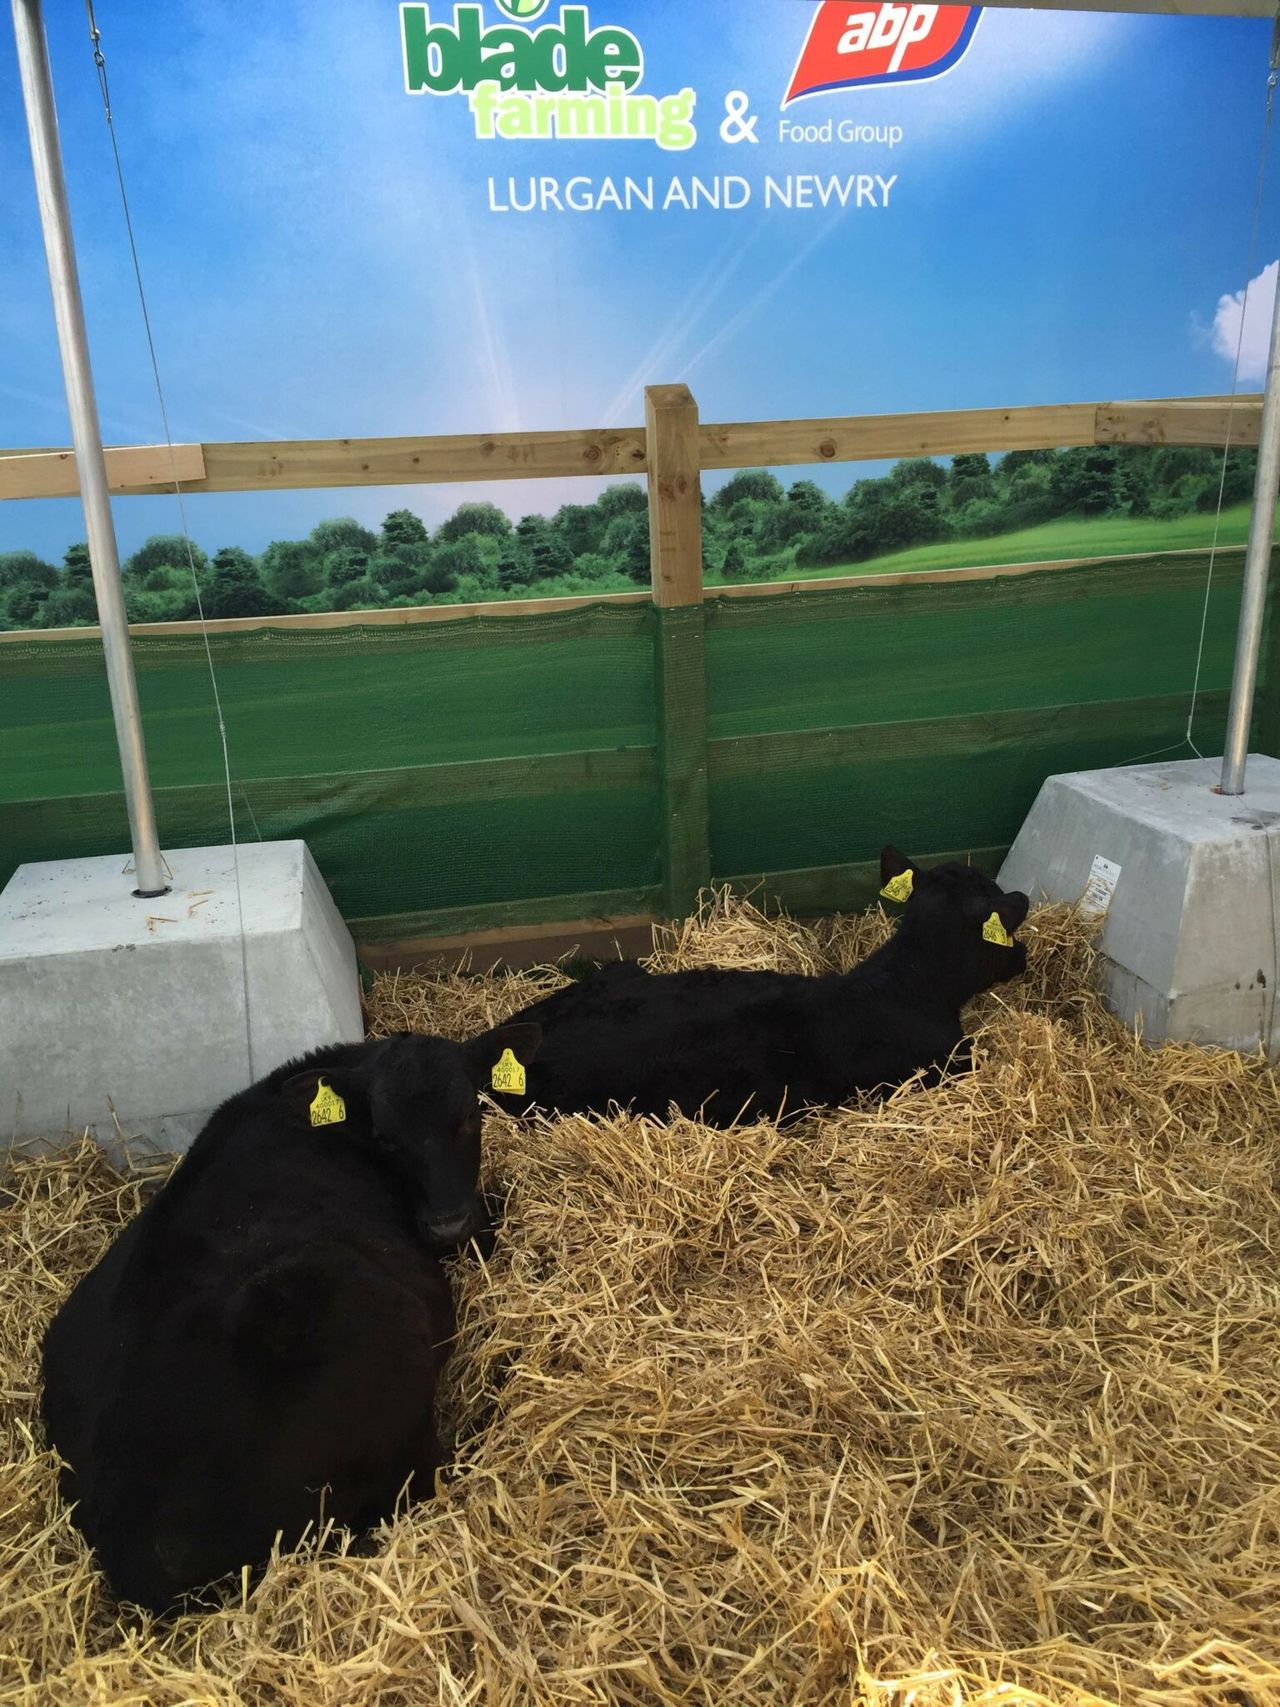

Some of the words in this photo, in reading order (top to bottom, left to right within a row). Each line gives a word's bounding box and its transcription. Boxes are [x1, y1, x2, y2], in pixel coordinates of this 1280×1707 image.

[401, 4, 642, 94] blade
[837, 3, 939, 73] abp
[470, 81, 697, 149] farming
[719, 90, 760, 144] &
[779, 119, 832, 143] Food
[838, 120, 903, 149] Group
[488, 176, 653, 211] LURGAN
[662, 175, 751, 210] AND
[765, 175, 898, 208] NEWRY
[493, 1073, 512, 1088] 2642
[518, 1072, 524, 1087] 6
[312, 1107, 331, 1125] 2642
[339, 1105, 345, 1120] 6
